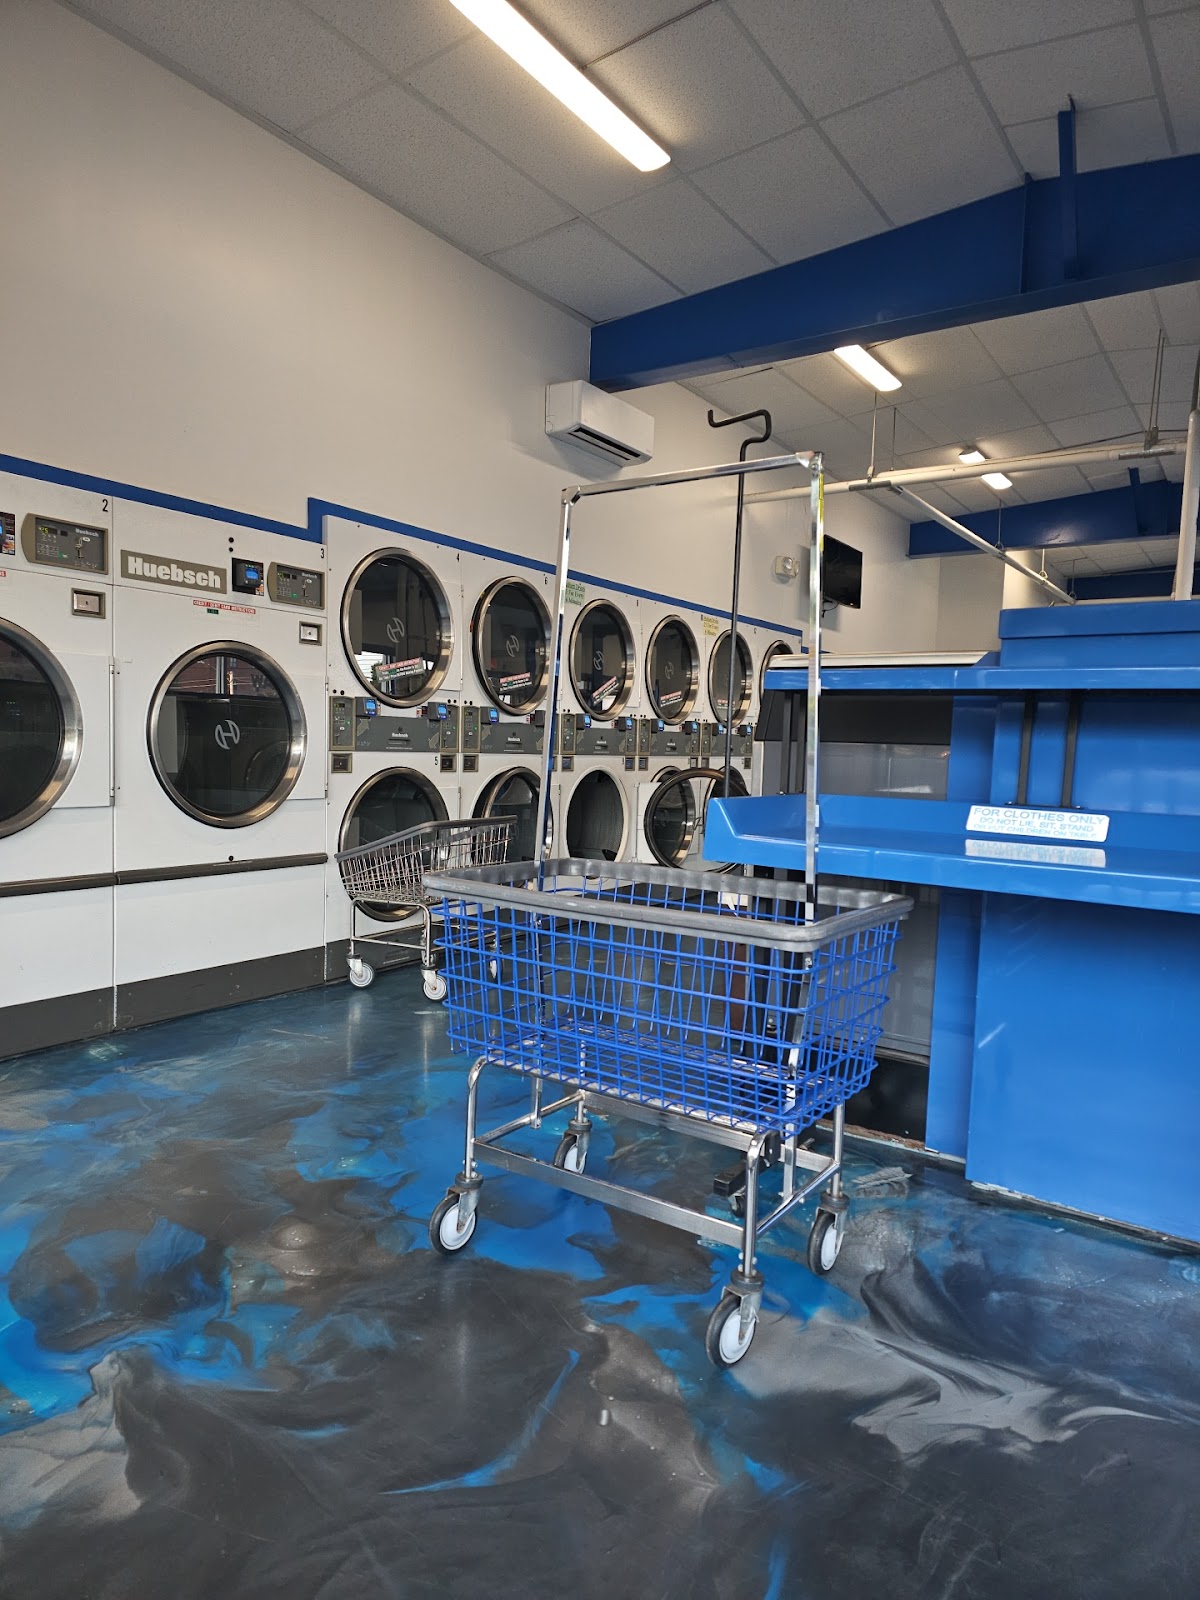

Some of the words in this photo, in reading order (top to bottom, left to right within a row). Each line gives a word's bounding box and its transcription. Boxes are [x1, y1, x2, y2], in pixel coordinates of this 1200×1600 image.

[102, 498, 109, 513] 2
[320, 547, 325, 559] 3
[456, 552, 460, 562] 4
[127, 555, 221, 589] Huebsch
[434, 756, 439, 766] 5
[974, 808, 1000, 816] FOR
[1004, 810, 1065, 821] CLOTHES
[1069, 815, 1106, 824] ONLY
[1006, 826, 1051, 836] CHILDREN
[1060, 824, 1094, 832] STAND
